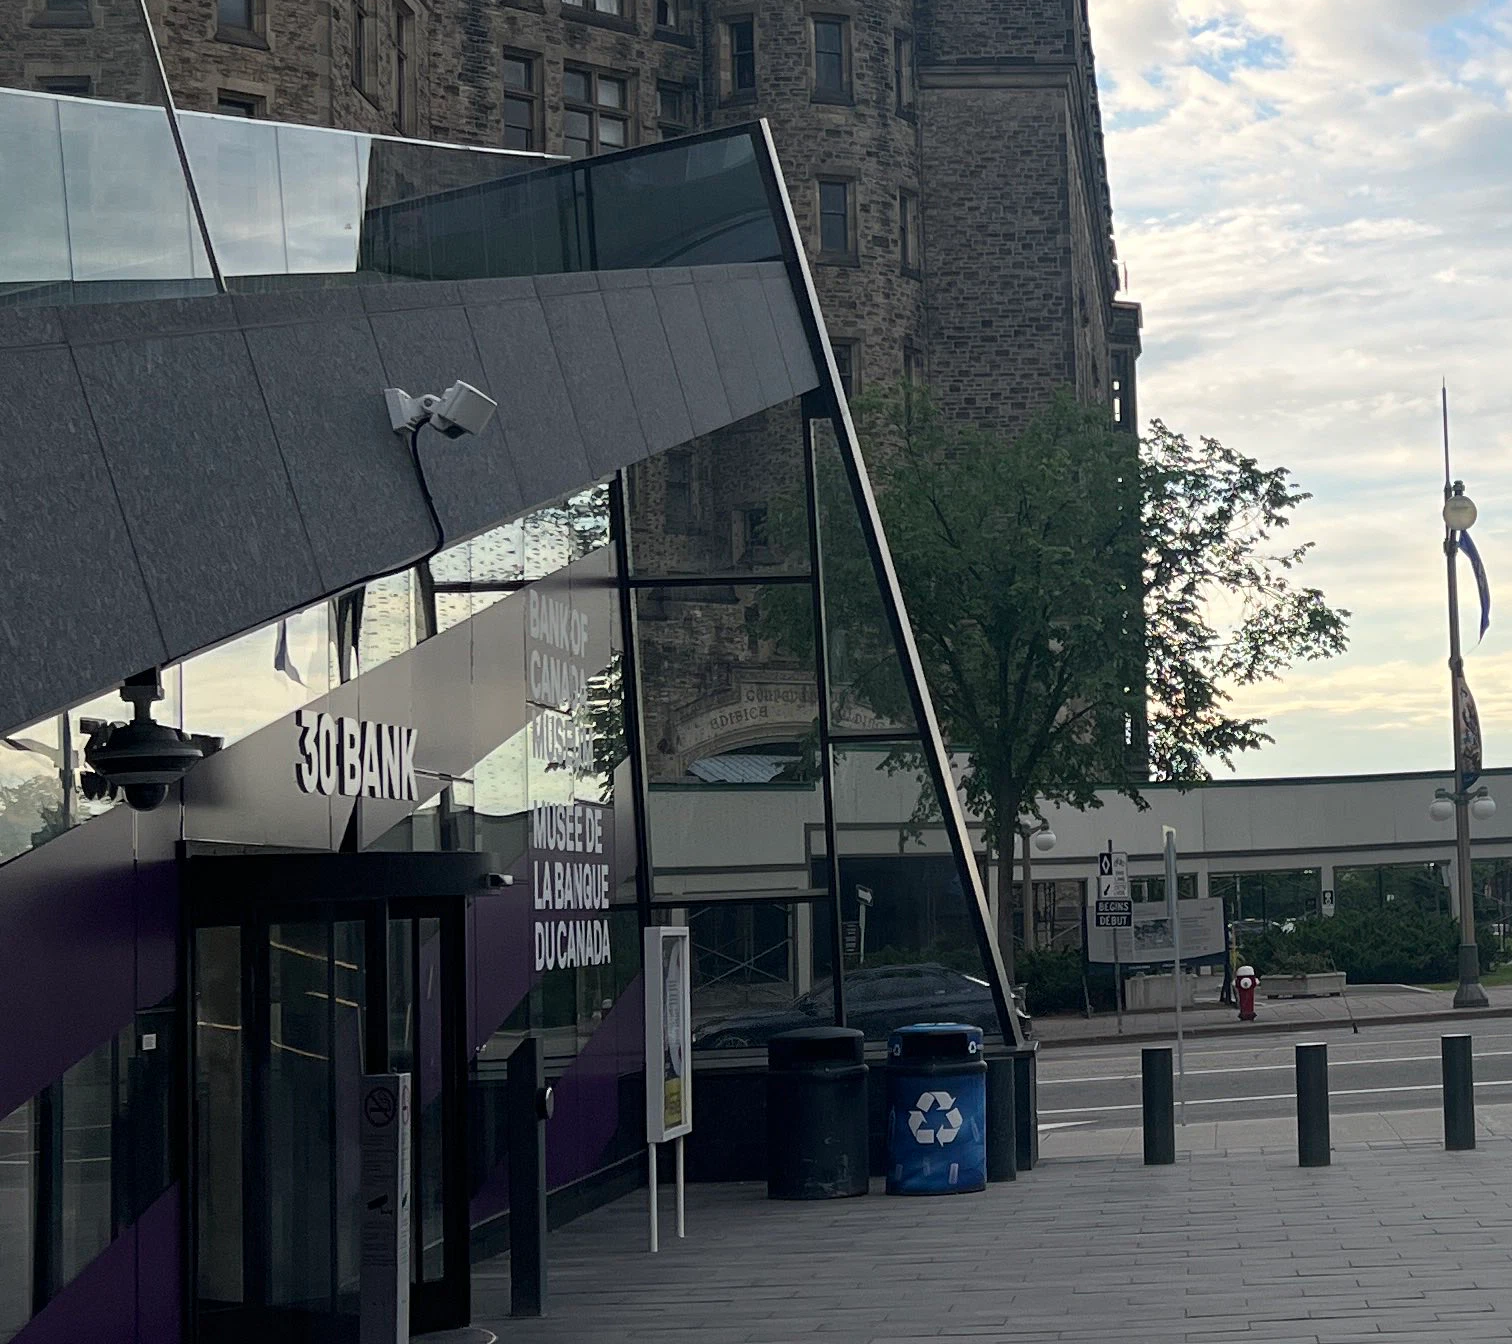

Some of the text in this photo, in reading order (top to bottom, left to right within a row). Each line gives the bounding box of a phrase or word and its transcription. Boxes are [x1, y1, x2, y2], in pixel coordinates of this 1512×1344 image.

[529, 589, 588, 657] BANK OF
[530, 650, 588, 708] CANADA
[296, 710, 418, 801] 30 BANK
[532, 708, 594, 773] MUSEUM
[585, 808, 603, 854] DE
[534, 860, 609, 909] LA BANQUE
[1098, 902, 1129, 912] BEGINS
[535, 919, 611, 971] DU CANADA
